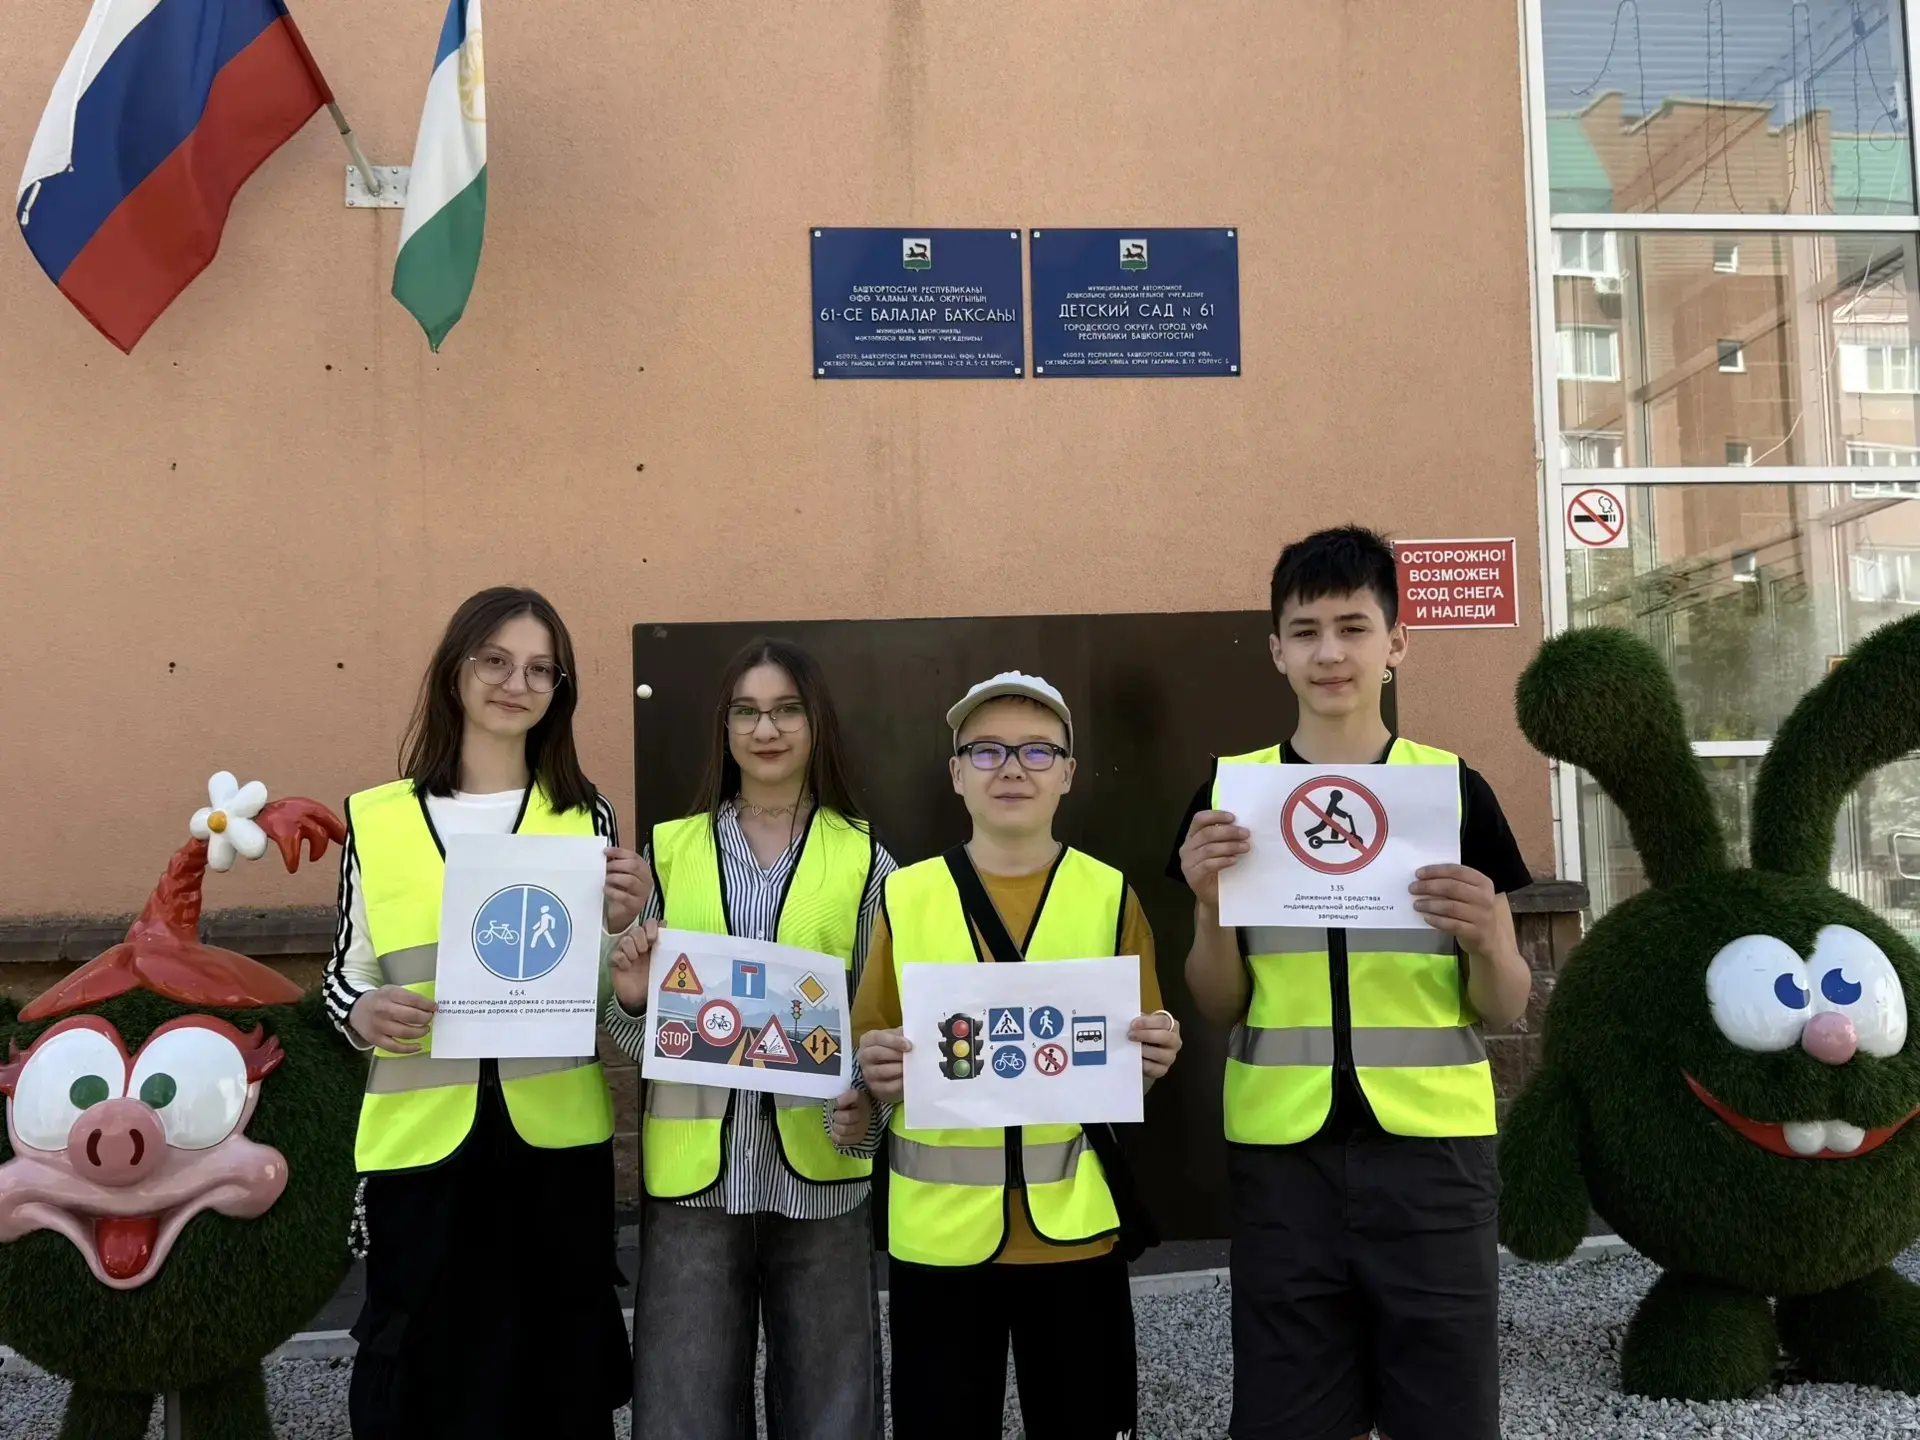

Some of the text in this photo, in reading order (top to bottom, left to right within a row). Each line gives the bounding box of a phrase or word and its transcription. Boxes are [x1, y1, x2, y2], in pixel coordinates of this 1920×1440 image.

[821, 308, 1015, 321] 61-СЕ БАЛАЛАР БАҠСАҺЫ
[1059, 301, 1129, 318] ДЕТСКИЙ
[1139, 304, 1174, 318] САД
[1200, 303, 1214, 316] 61
[1401, 549, 1506, 563] ОСТОРОЖНО!
[1410, 568, 1500, 582] ВОЗМОЖЕН
[1407, 586, 1504, 602] СХОД СНЕГА
[1417, 605, 1495, 619] И НАЛЕДИ
[661, 1031, 688, 1046] STOP
